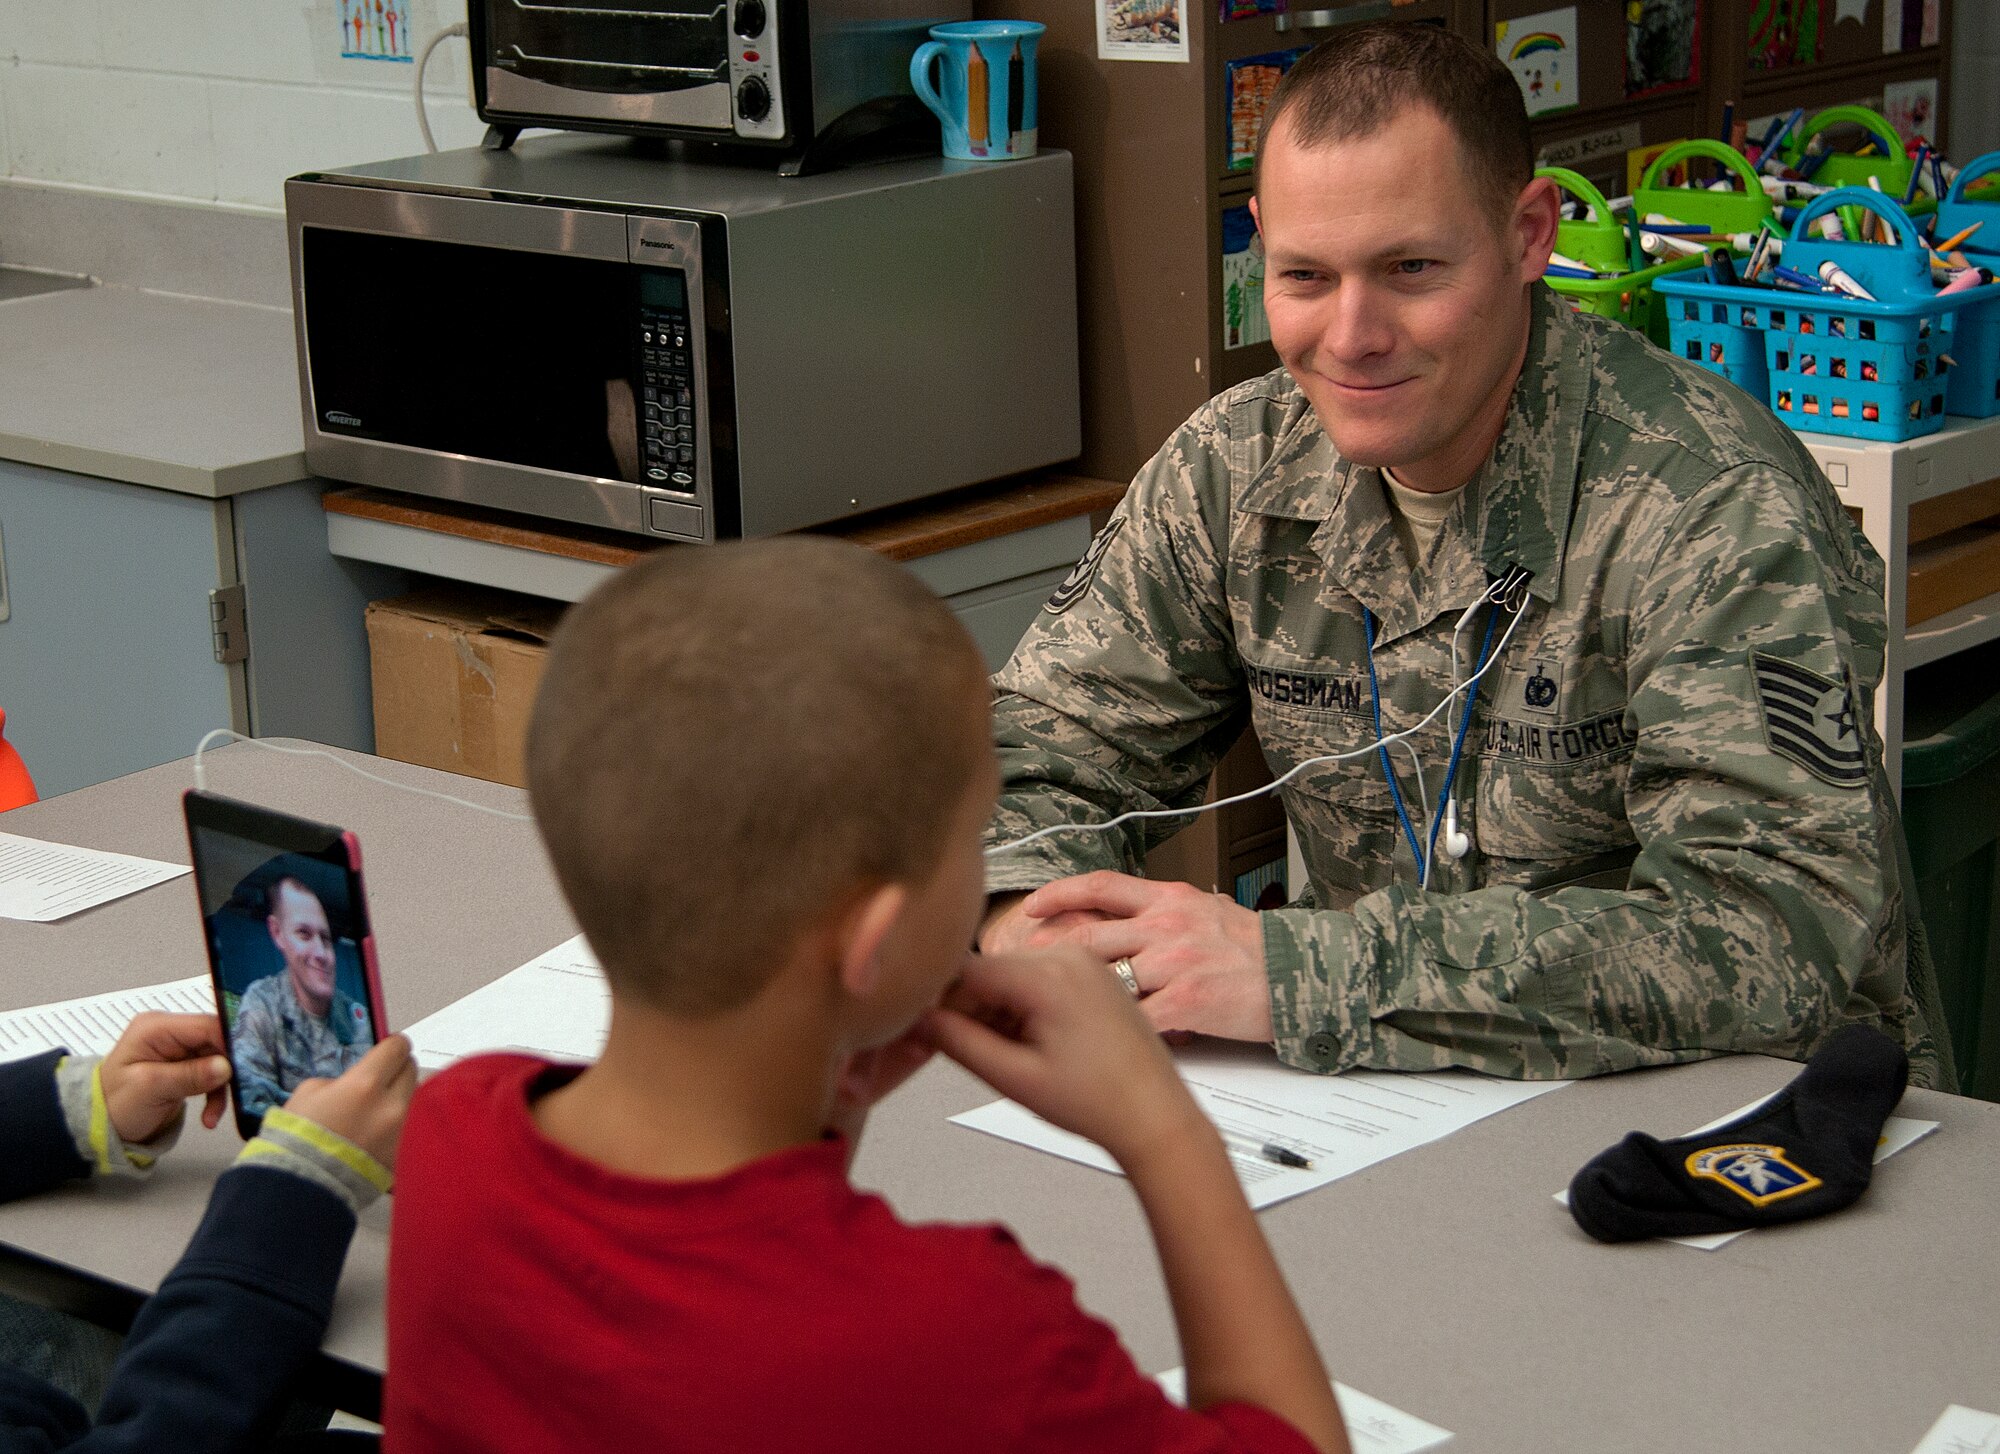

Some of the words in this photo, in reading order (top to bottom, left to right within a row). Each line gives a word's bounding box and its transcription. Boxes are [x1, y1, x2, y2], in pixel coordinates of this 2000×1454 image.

[640, 238, 675, 250] Panasonic
[328, 415, 362, 427] INVERTER
[1241, 656, 1361, 711] ROSSMAN
[1487, 718, 1513, 752] U.S.
[1517, 724, 1542, 760] AIR
